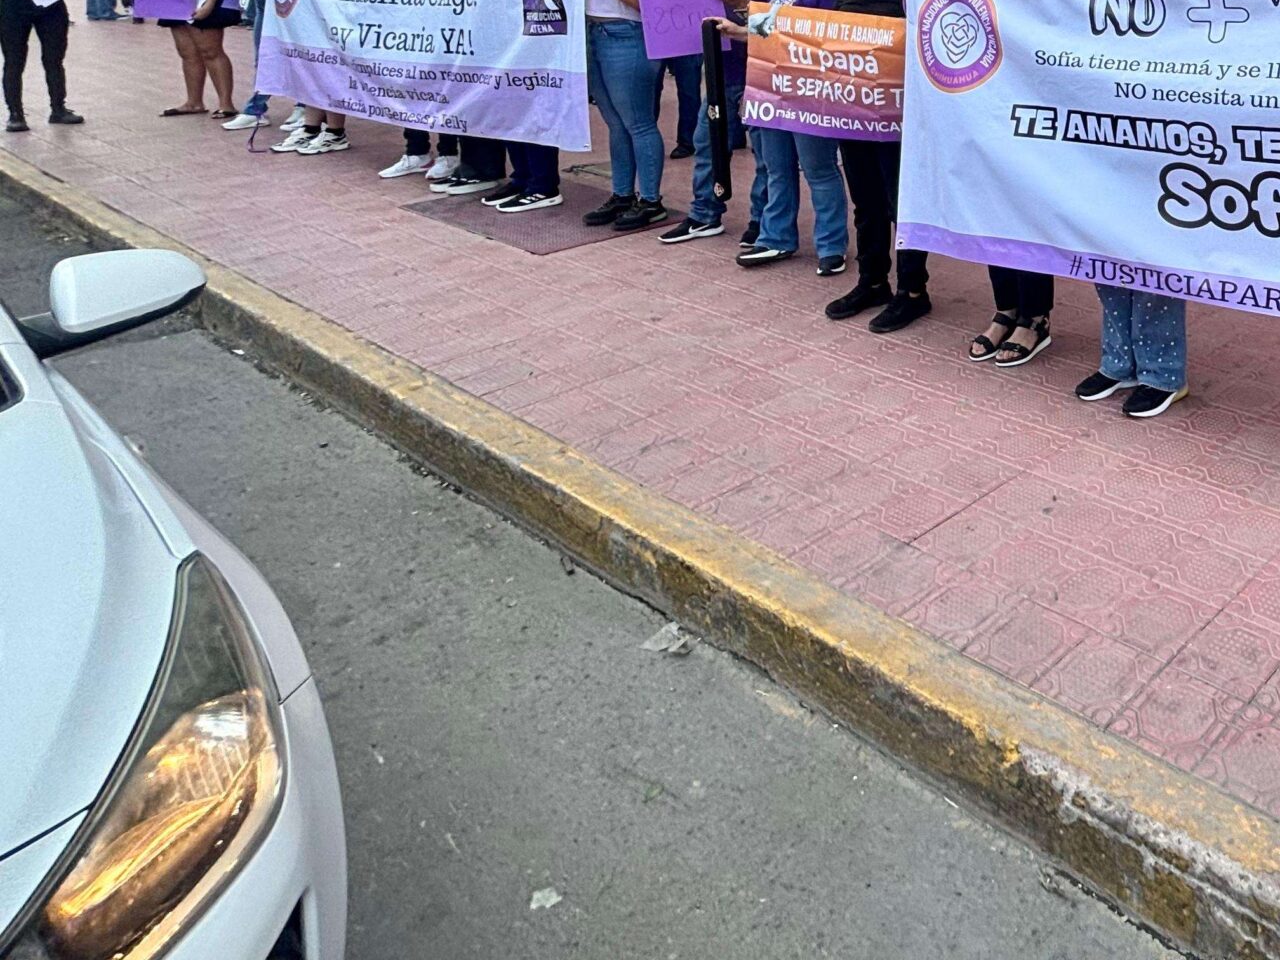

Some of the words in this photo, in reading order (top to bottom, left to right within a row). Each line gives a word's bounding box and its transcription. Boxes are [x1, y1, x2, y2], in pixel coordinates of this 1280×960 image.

[328, 25, 354, 52] ey
[357, 23, 435, 53] Vicaria
[440, 27, 475, 56] YA!
[529, 23, 555, 33] ATENA
[815, 20, 826, 38] YO
[827, 21, 839, 39] NO
[840, 23, 851, 41] TE
[787, 41, 813, 65] tu
[818, 48, 879, 76] papá
[921, 33, 936, 67] FRENTE
[979, 34, 998, 68] VICARIA
[1034, 49, 1084, 69] Sofía
[1088, 53, 1141, 72] tiene
[1144, 59, 1213, 77] mamá
[1215, 65, 1232, 81] y
[1236, 64, 1261, 79] se
[419, 69, 437, 81] no
[494, 75, 502, 90] y
[505, 72, 565, 92] legislar
[771, 73, 793, 93] ME
[796, 77, 856, 104] SEPARÓ
[861, 86, 886, 106] DE
[930, 67, 979, 85] CHIHUAHUA
[1113, 81, 1147, 100] NO
[1151, 86, 1245, 107] necesita
[744, 100, 775, 121] NO
[775, 108, 796, 120] más
[798, 111, 864, 130] VIOLENCIA
[864, 120, 904, 132] VICA
[1010, 104, 1059, 140] TE
[1062, 109, 1228, 166] AMAMOS,
